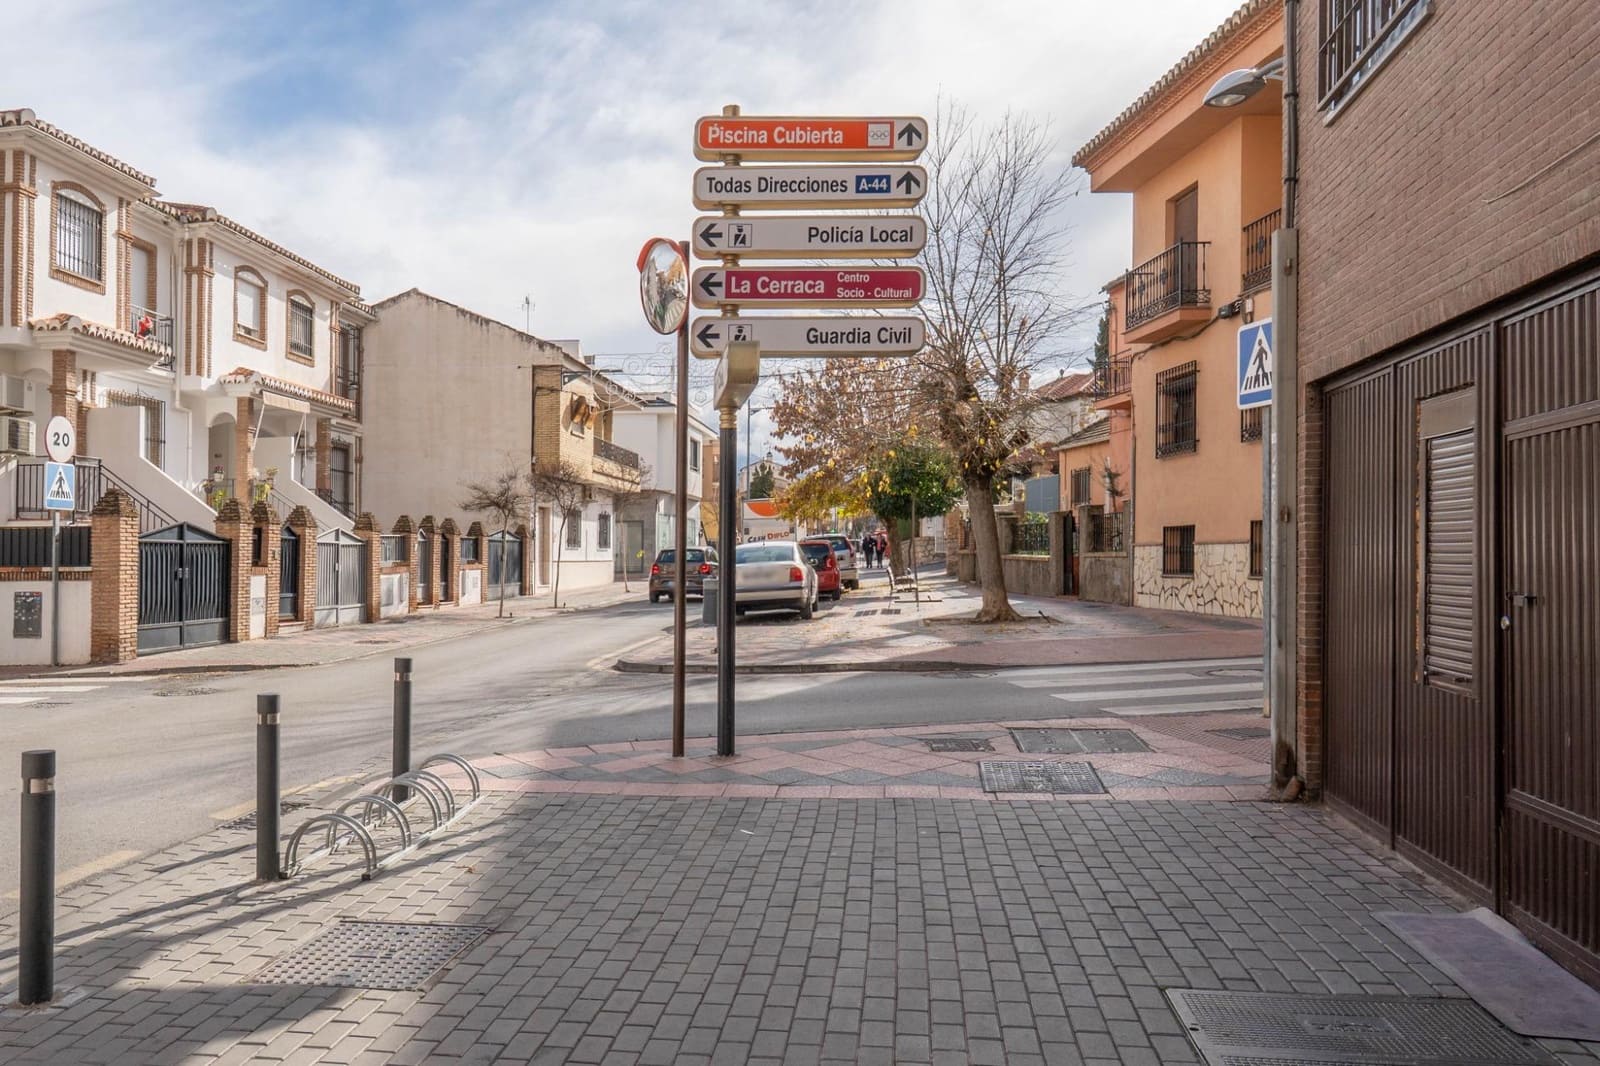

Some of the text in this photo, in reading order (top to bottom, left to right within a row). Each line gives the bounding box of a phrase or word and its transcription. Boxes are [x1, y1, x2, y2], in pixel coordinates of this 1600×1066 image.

[708, 125, 844, 144] Piscina Cubierta
[706, 177, 848, 193] Todas Direcciones
[859, 178, 888, 191] A-44
[808, 226, 913, 243] Policía Local
[730, 277, 825, 293] La Cerraca
[837, 272, 870, 283] Centro
[836, 288, 865, 298] Socio
[874, 288, 912, 298] Cultural
[806, 328, 912, 344] Guardia Civil
[53, 432, 70, 447] 20
